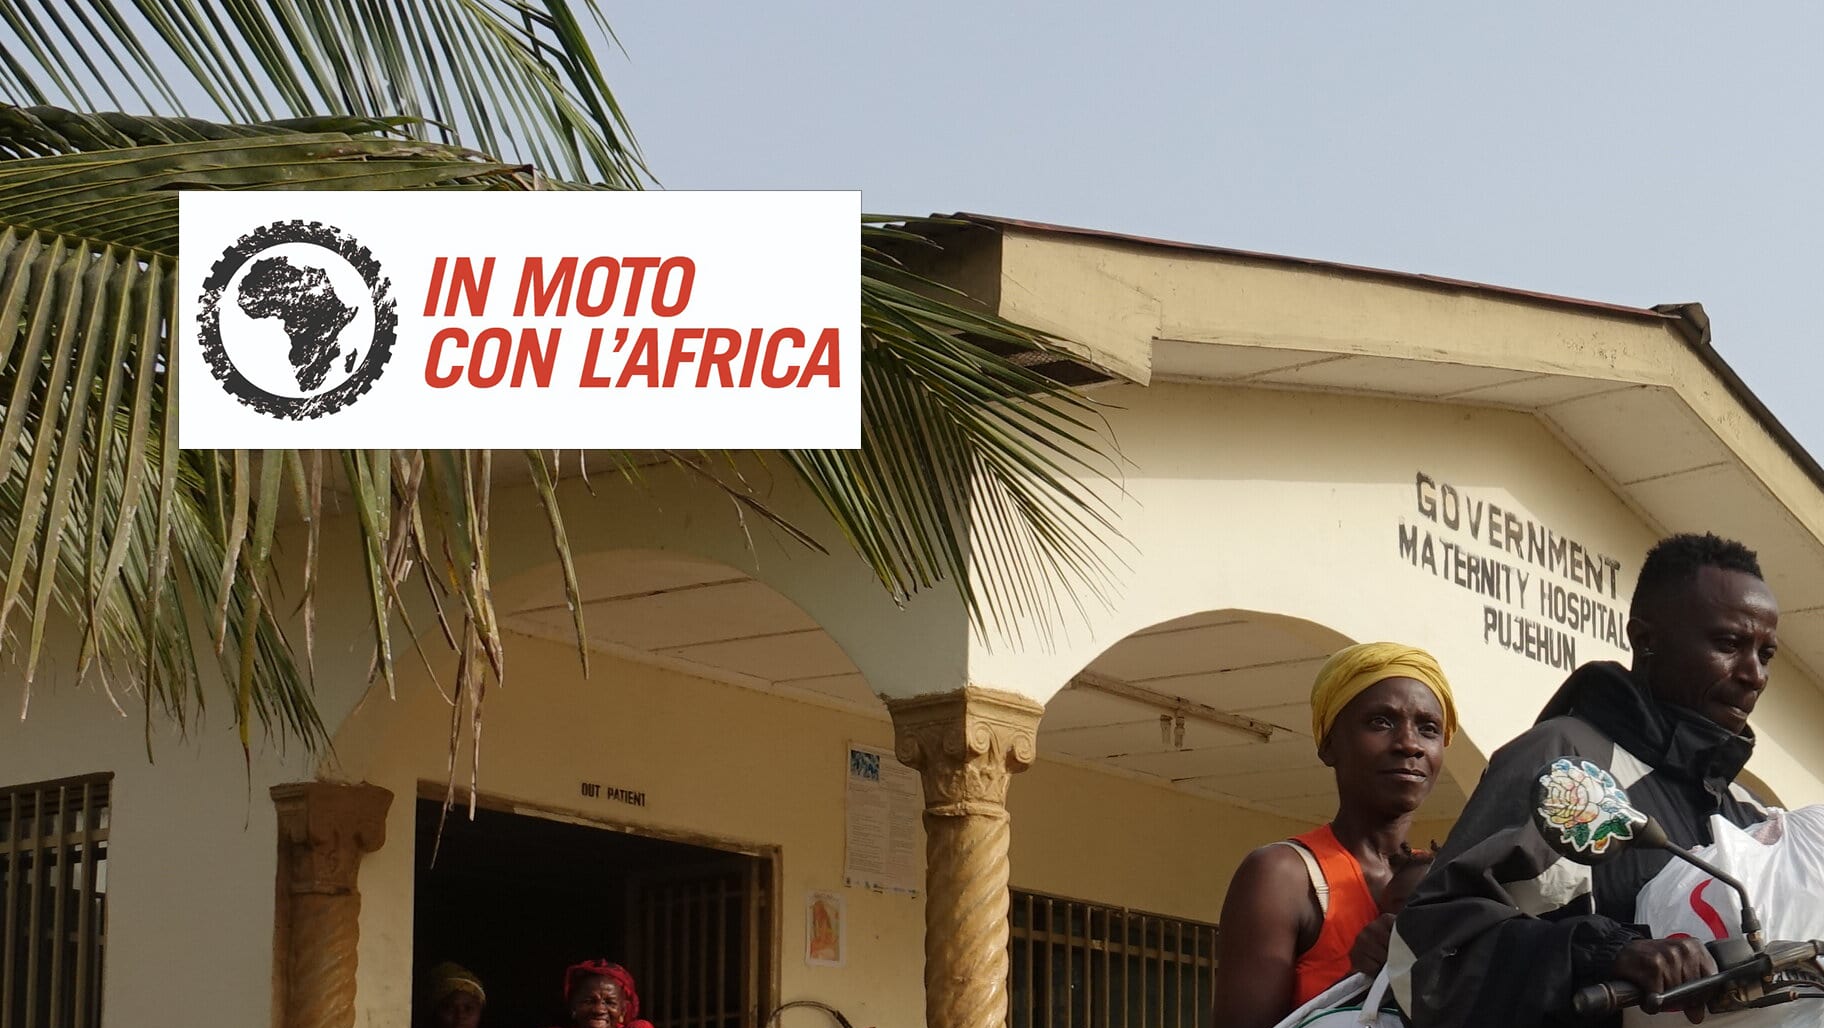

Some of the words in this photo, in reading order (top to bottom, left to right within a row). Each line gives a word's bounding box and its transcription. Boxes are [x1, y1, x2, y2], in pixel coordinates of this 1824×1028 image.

[1416, 472, 1621, 600] GOVERNMENT
[1399, 523, 1530, 609] MATERNITY
[1540, 579, 1631, 652] HOSPITAL
[1484, 605, 1576, 672] PUJEHUN
[582, 783, 601, 797] OUT
[608, 787, 646, 806] PATIENT
